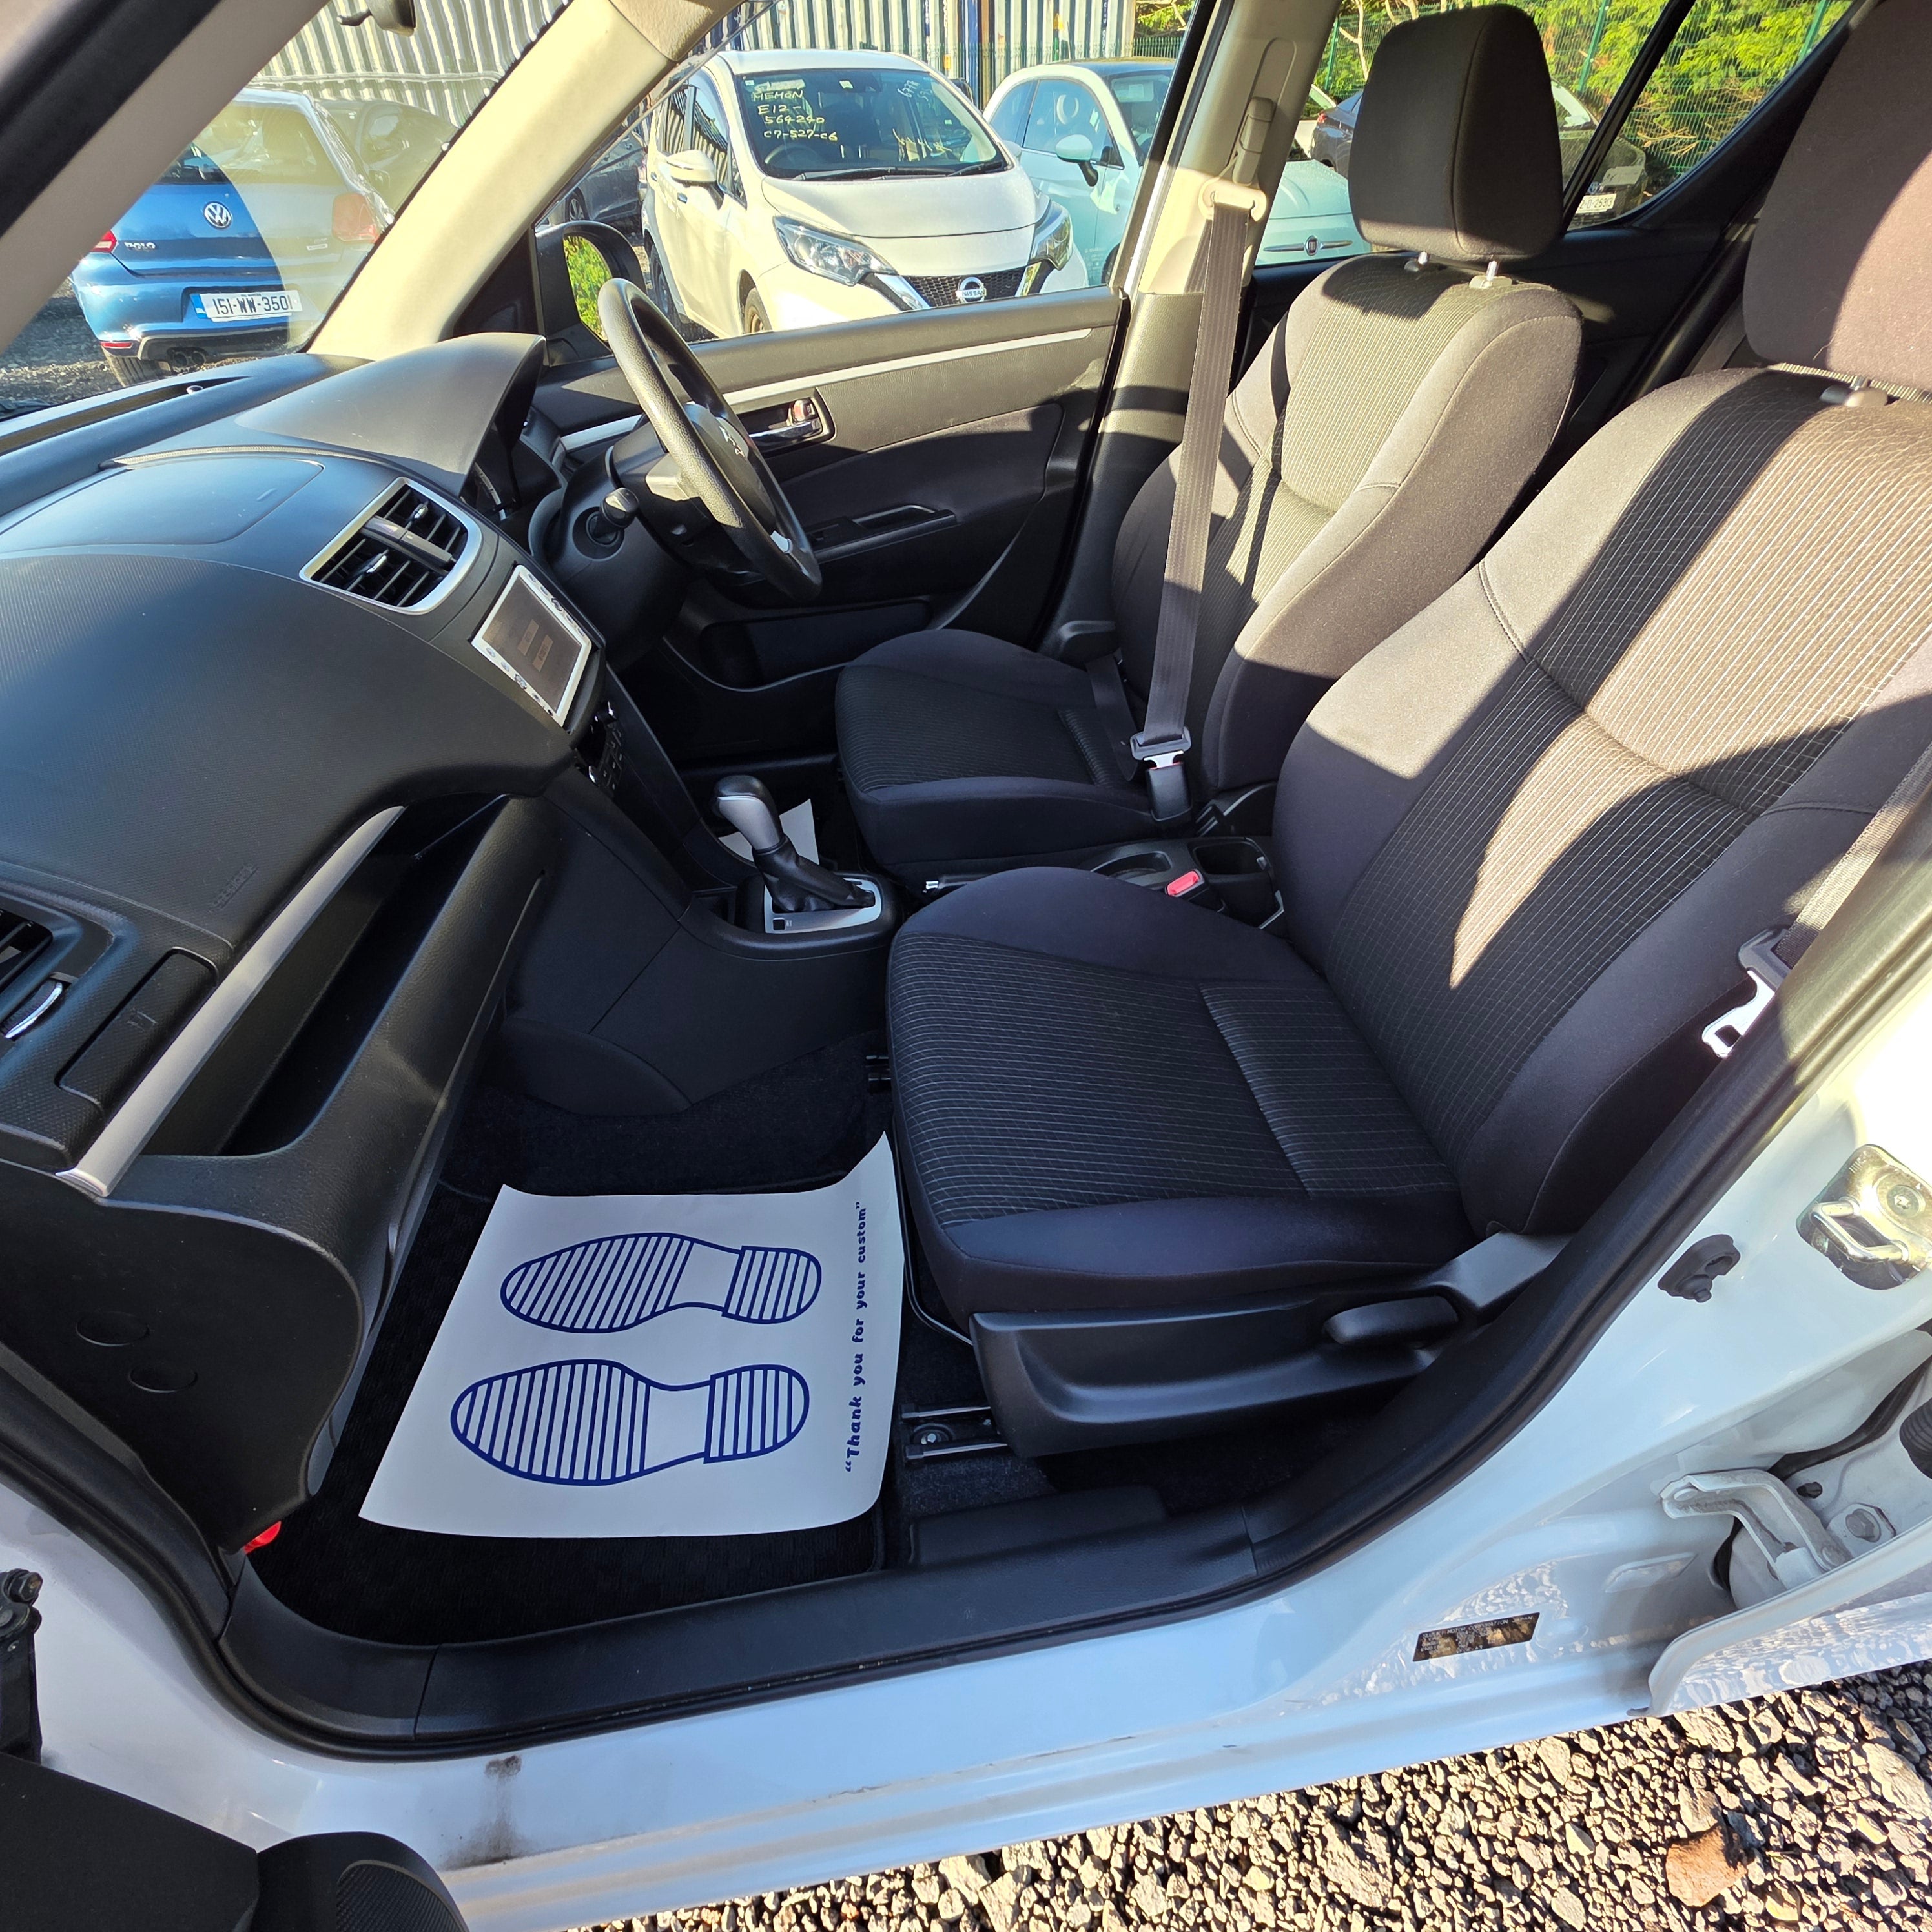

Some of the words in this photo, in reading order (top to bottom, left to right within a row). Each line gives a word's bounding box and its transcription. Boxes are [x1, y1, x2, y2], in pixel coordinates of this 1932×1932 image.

[765, 115, 825, 124] 564240
[212, 294, 293, 314] 151-WW-3501
[856, 1271, 868, 1310] your
[851, 1318, 864, 1343] for
[852, 1353, 866, 1387] you
